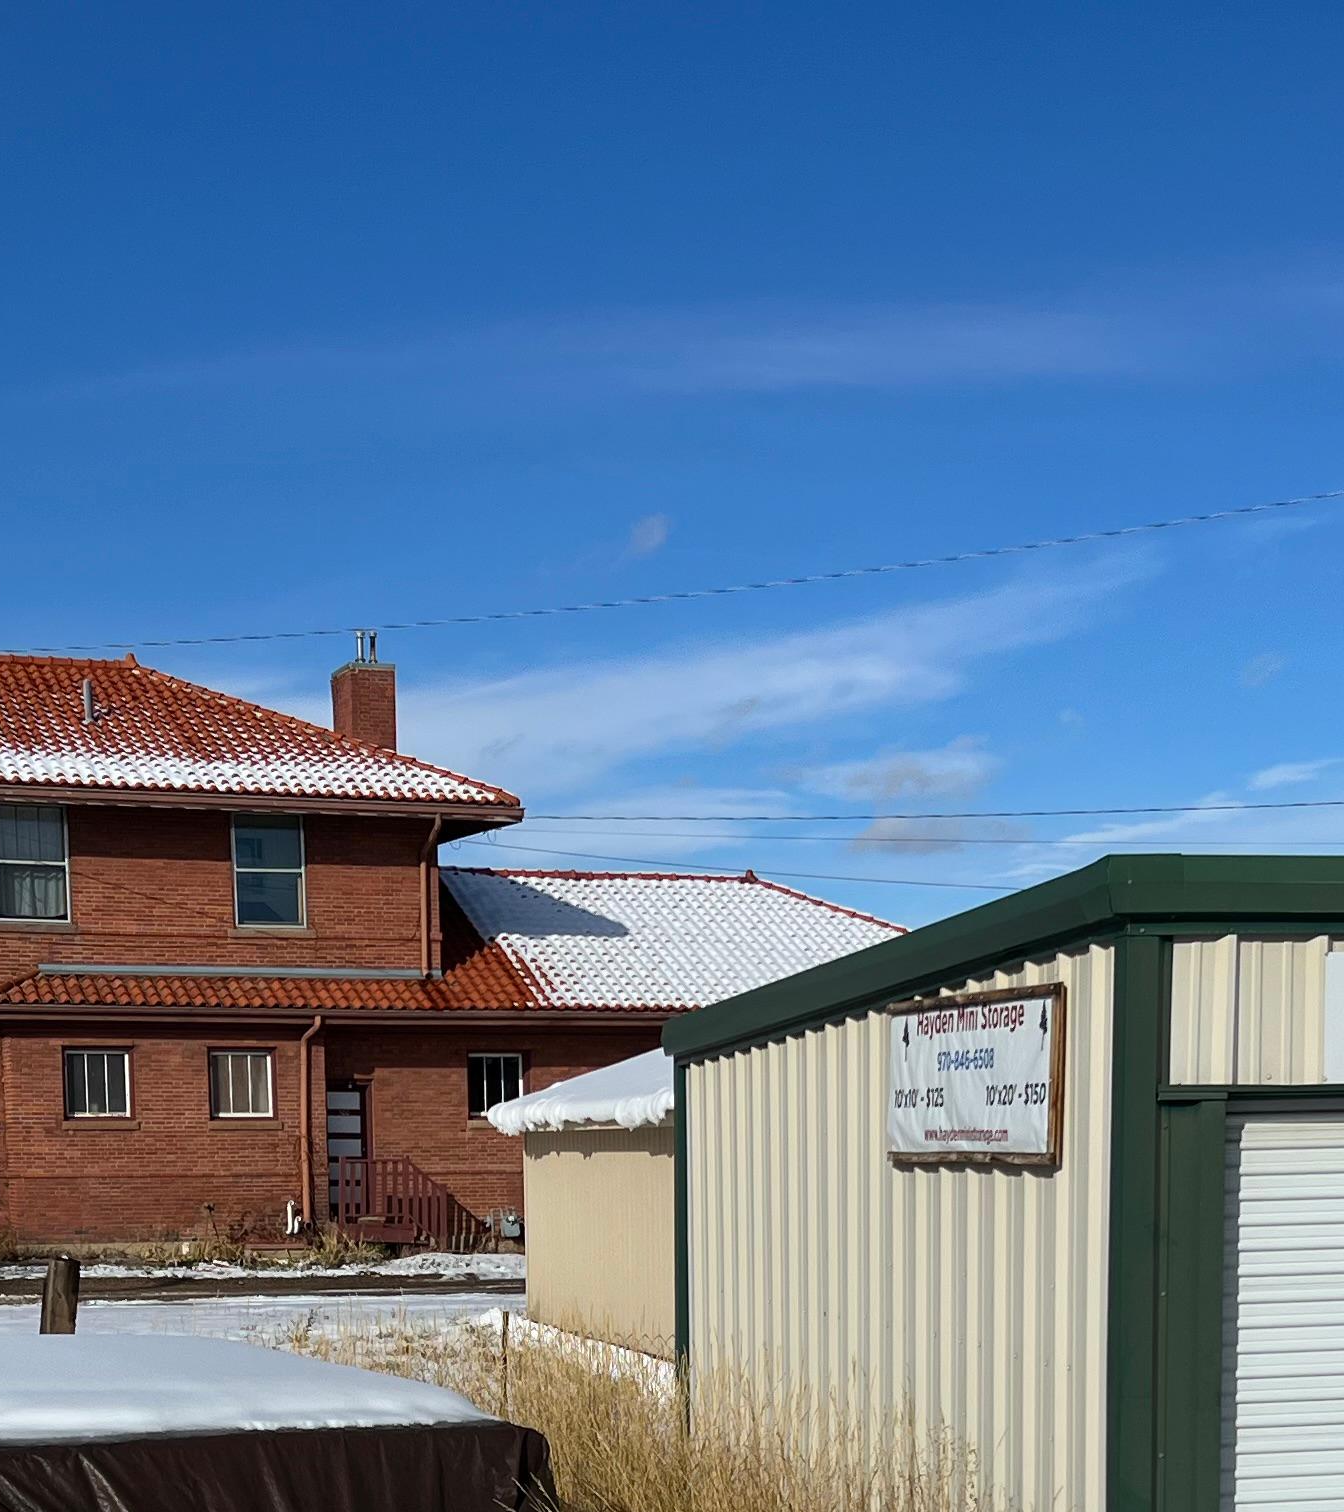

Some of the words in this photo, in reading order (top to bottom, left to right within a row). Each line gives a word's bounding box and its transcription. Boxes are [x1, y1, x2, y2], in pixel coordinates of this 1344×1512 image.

[916, 1007, 954, 1041] Hayden
[956, 1003, 979, 1033] Mini
[980, 1001, 1025, 1032] Storage
[937, 1047, 995, 1072] 970-846-6508
[926, 1087, 945, 1110] $125
[1023, 1082, 1047, 1106] $150
